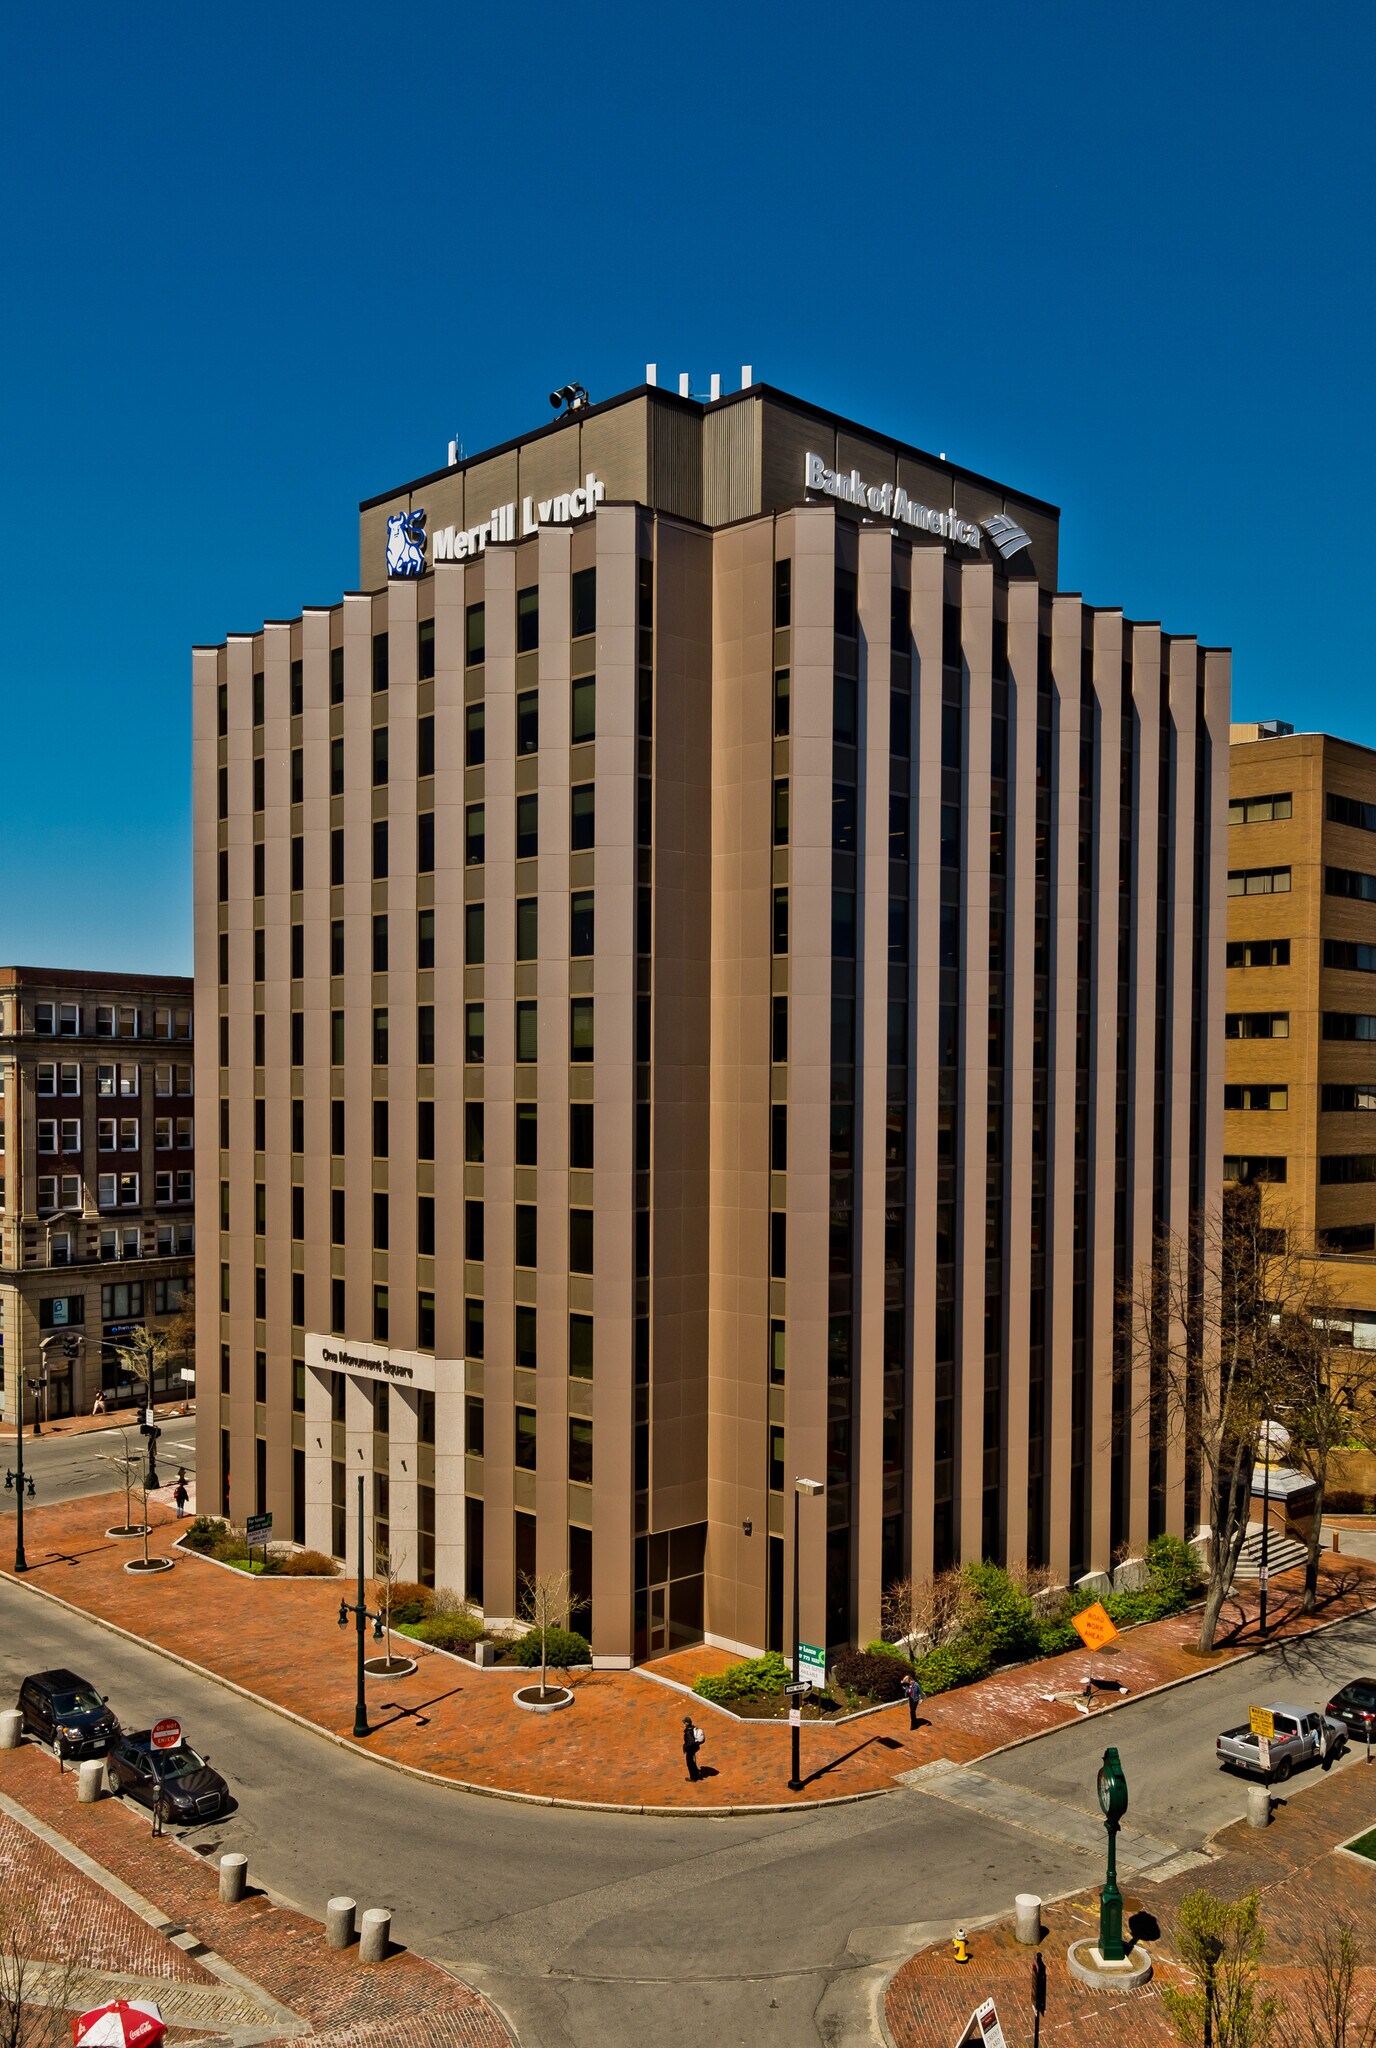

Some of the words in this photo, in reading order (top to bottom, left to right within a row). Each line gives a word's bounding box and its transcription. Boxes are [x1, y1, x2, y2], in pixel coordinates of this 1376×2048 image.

[805, 452, 867, 507] Bank
[867, 482, 894, 515] of
[893, 487, 982, 549] America
[433, 502, 516, 562] Merrill
[523, 472, 605, 535] Lynch
[322, 1348, 338, 1364] One
[339, 1351, 382, 1373] Monument
[383, 1360, 414, 1379] Square
[1087, 1612, 1105, 1623] ROAD
[1086, 1622, 1104, 1632] WORK
[1084, 1630, 1105, 1641] AHEAD
[1251, 1708, 1272, 1719] WARNING
[157, 1736, 175, 1744] ENTER
[129, 2020, 153, 2040] Coca-Cola
